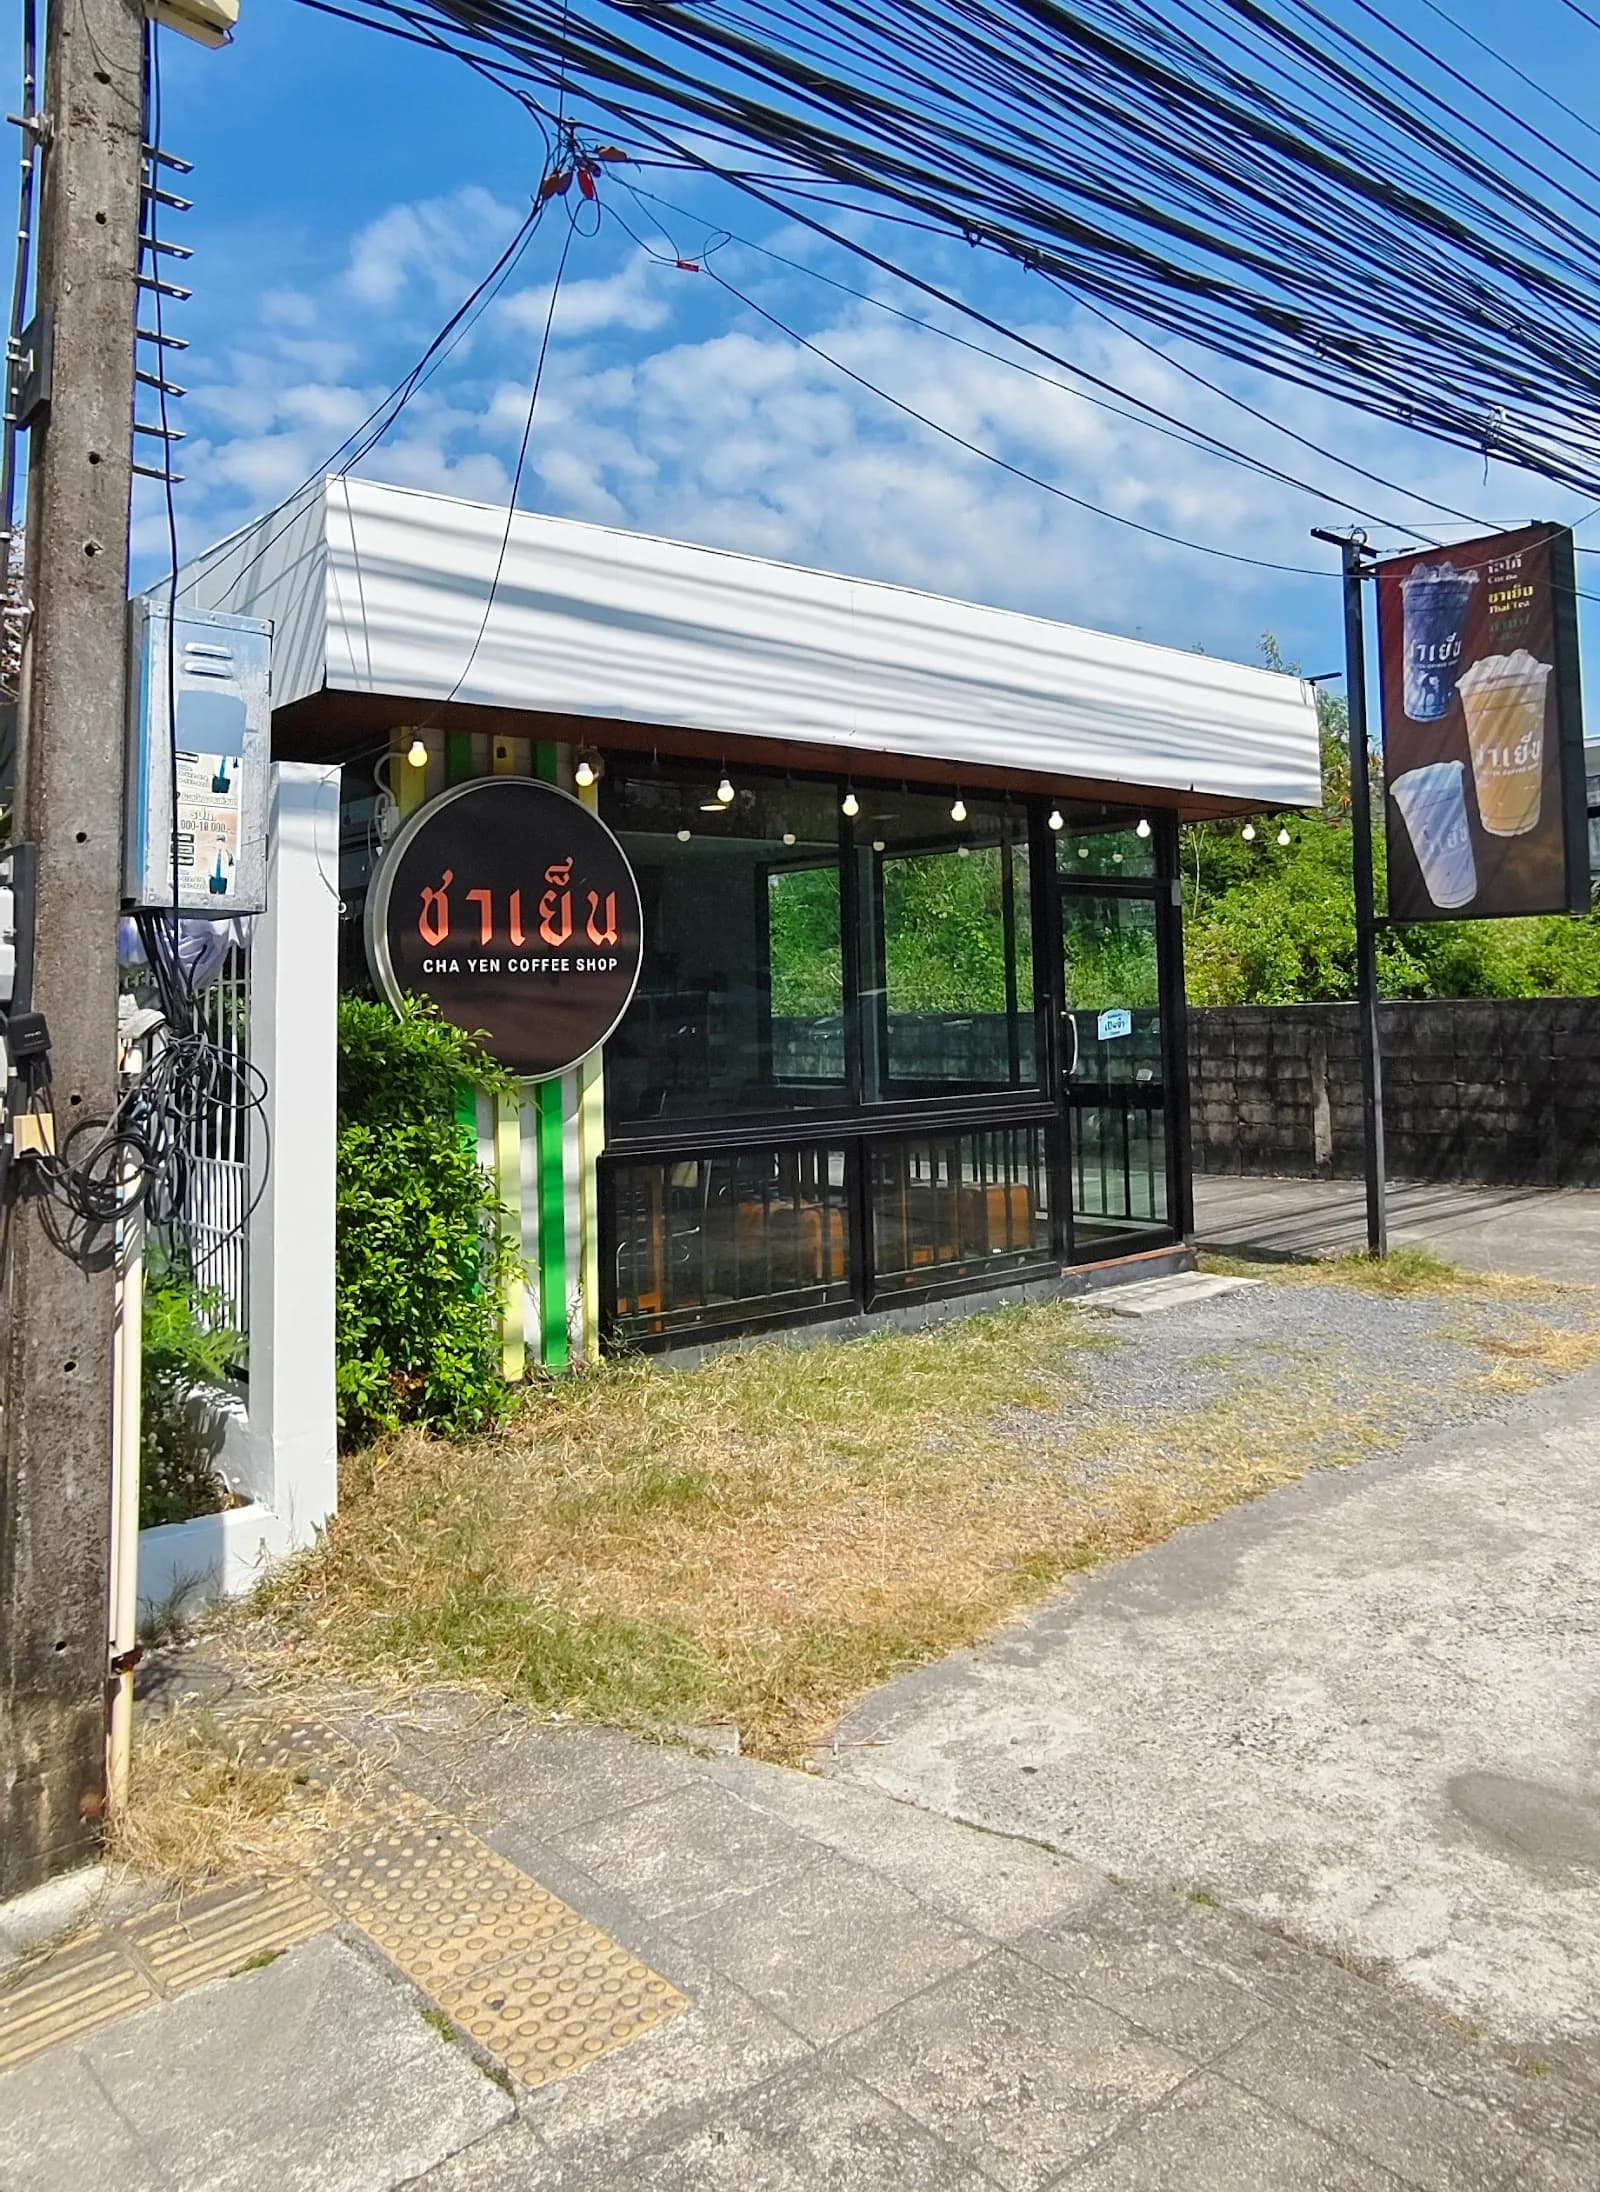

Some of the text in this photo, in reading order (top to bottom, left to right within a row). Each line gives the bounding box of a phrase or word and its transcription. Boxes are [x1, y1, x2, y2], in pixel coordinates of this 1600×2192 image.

[1489, 600, 1530, 614] Thai Tea
[418, 855, 619, 947] ชาเย็น
[422, 957, 618, 974] CHA YEN COFFEE SHOP
